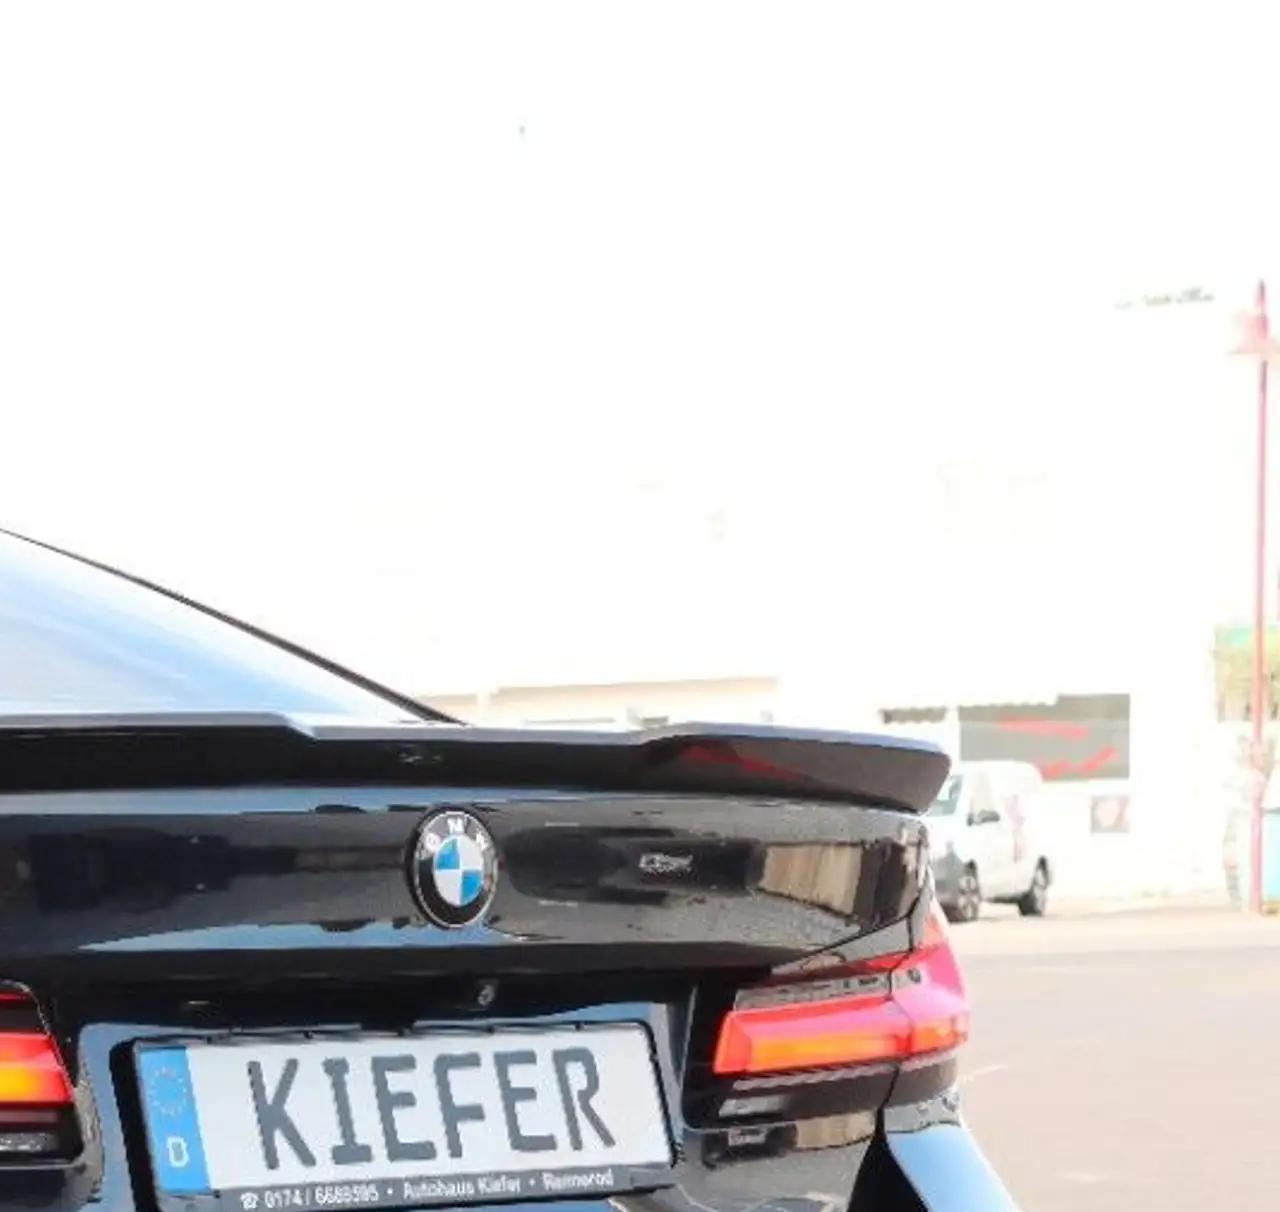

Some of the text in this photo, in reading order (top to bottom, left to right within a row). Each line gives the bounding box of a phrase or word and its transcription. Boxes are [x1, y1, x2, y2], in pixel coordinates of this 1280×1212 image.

[247, 1047, 616, 1171] KIEFER
[166, 1136, 189, 1168] D
[402, 1178, 475, 1200] Autohaus
[478, 1174, 521, 1196] Kiefer
